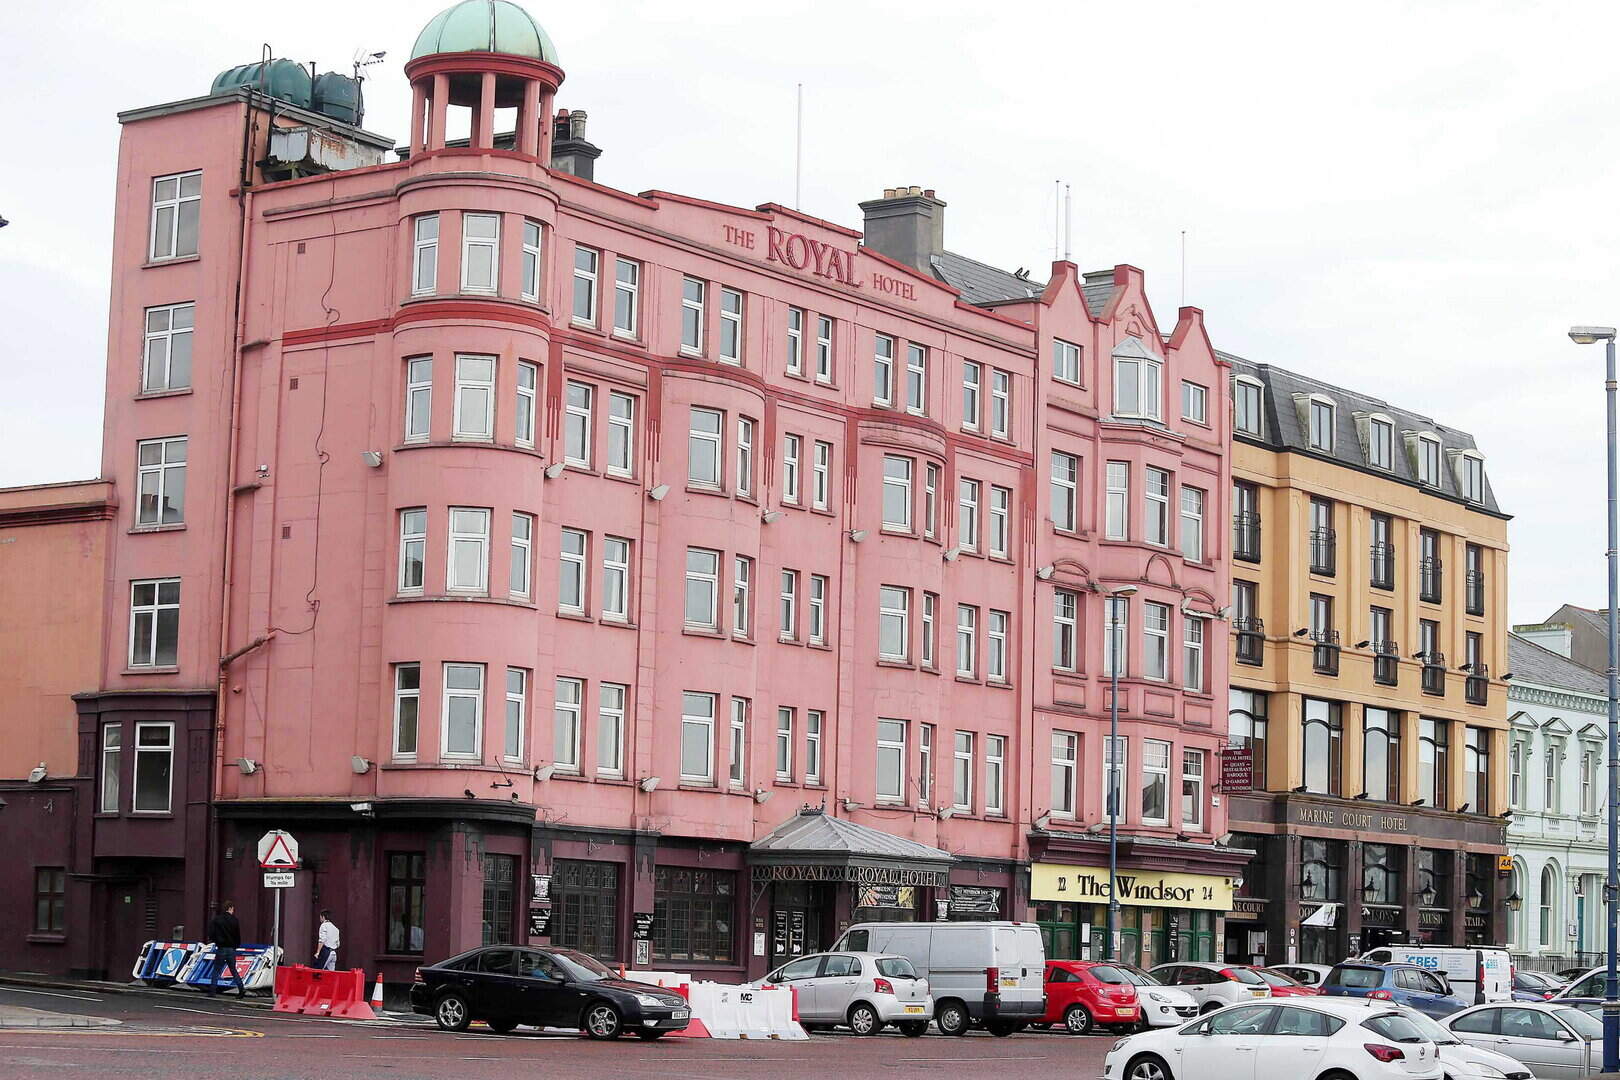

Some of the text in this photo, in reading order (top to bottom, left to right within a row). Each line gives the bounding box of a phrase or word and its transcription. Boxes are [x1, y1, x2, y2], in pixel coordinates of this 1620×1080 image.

[723, 224, 917, 301] THE ROYAL HOTEL
[1300, 807, 1408, 831] MARINE COURT HOTEL
[772, 865, 828, 881] ROYAL
[858, 867, 940, 887] ROYAL HOTEL
[1078, 874, 1110, 897] The
[1115, 876, 1194, 901] Windsor
[740, 993, 753, 1001] MC
